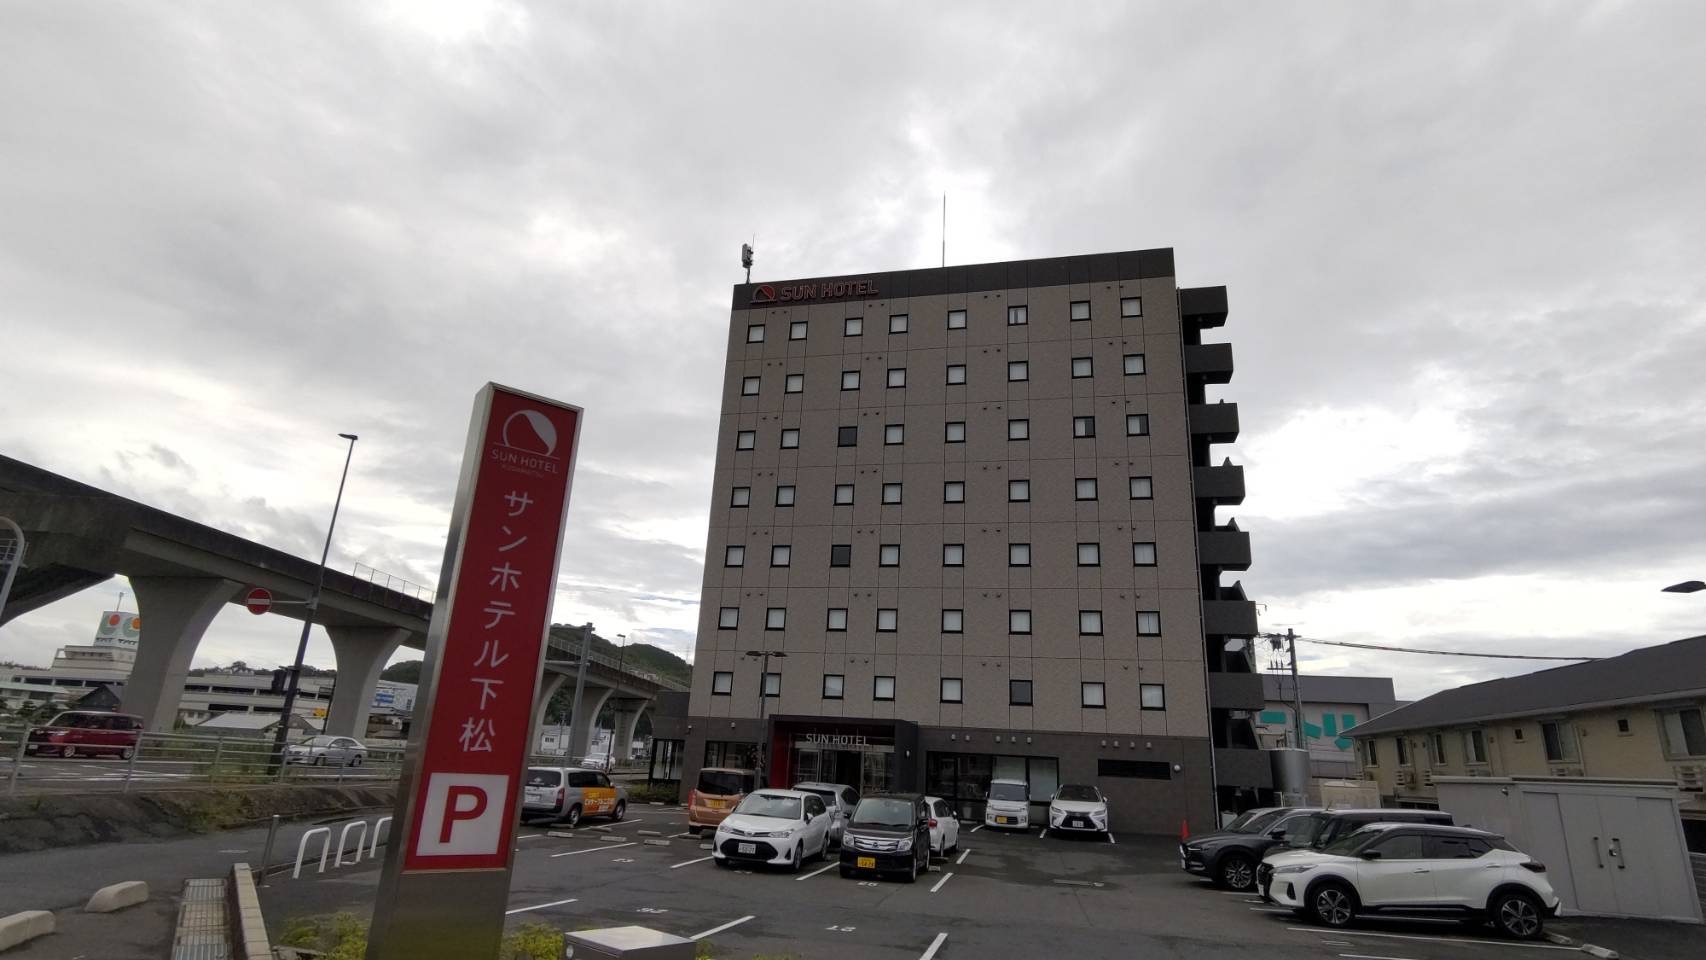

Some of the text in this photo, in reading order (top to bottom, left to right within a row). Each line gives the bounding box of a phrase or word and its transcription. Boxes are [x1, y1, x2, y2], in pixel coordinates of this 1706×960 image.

[781, 279, 880, 302] SUN HOTEL
[491, 448, 518, 464] SUN
[520, 456, 559, 474] HOTEL
[458, 490, 534, 753] サンホテル下松
[806, 733, 870, 746] SUN HOTEL
[438, 785, 489, 844] P
